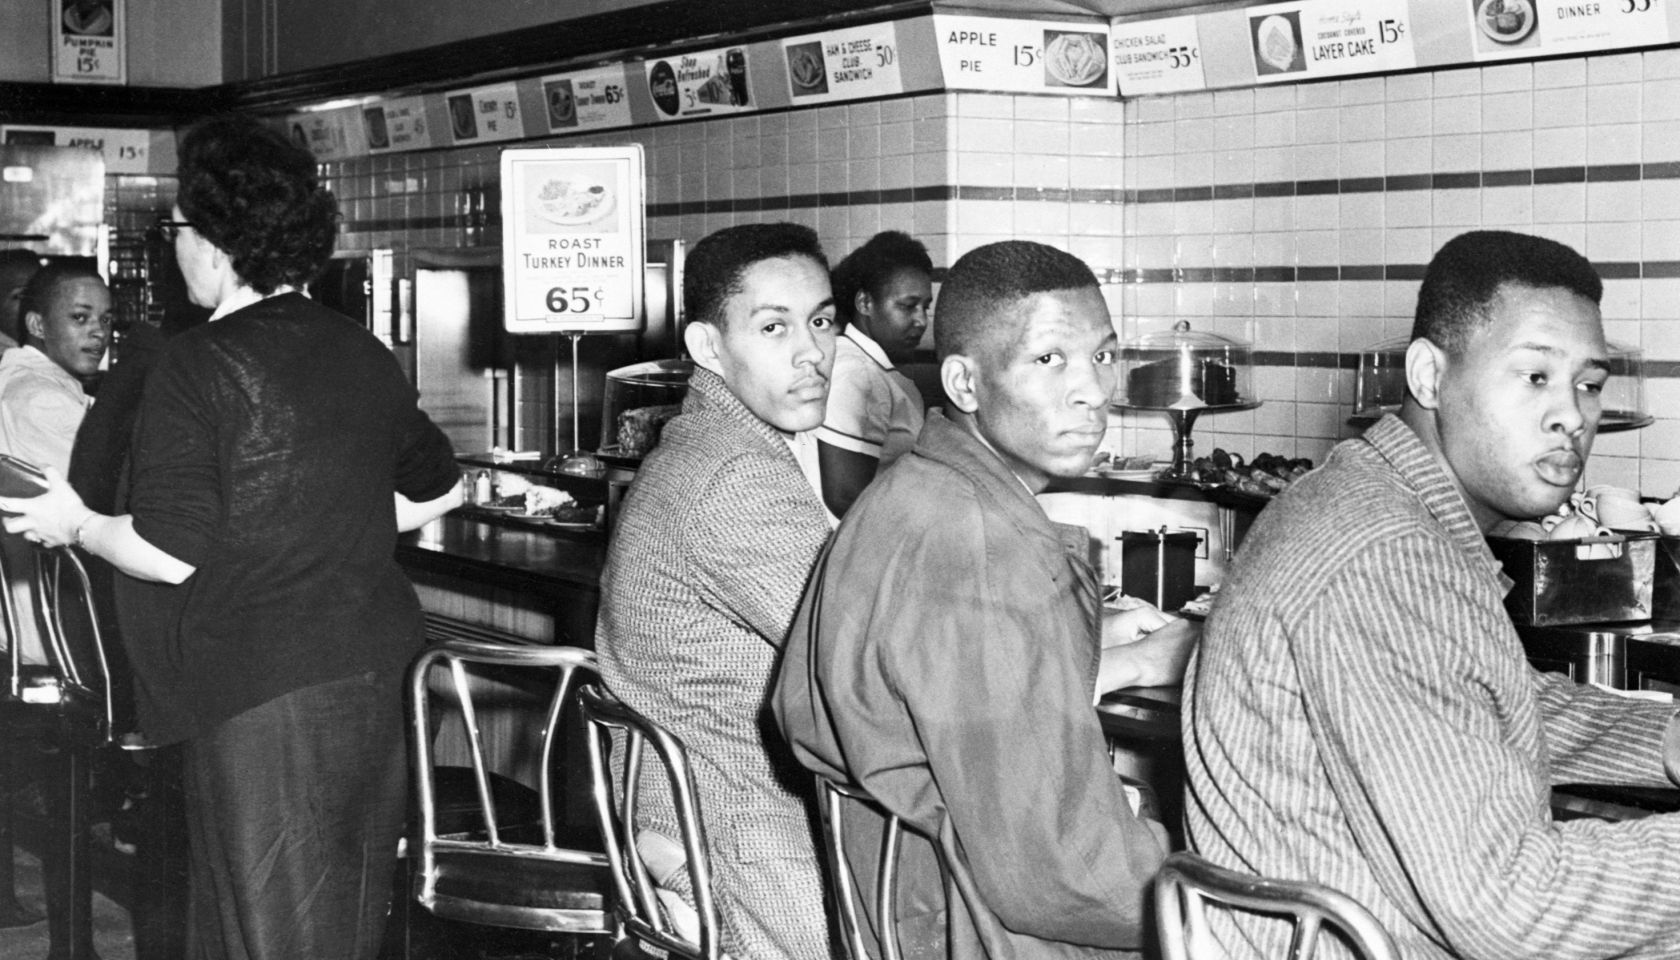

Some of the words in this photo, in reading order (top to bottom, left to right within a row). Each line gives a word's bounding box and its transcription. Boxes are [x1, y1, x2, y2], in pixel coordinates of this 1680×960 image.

[1557, 3, 1600, 19] DINNER
[948, 31, 997, 46] APPLE
[1379, 19, 1405, 44] 15¢
[64, 34, 114, 49] PUMPKIN
[826, 45, 840, 56] HAM
[848, 39, 872, 54] CHEESE
[1114, 36, 1143, 49] CHICKEN
[1145, 33, 1166, 46] SALAD
[80, 48, 96, 57] PIE
[1312, 42, 1344, 61] LAYER
[1348, 39, 1376, 57] CAKE
[842, 55, 860, 69] CLUB
[1115, 53, 1132, 65] CLUB
[1133, 51, 1168, 64] SANDWICH
[960, 60, 982, 72] PIE
[834, 68, 872, 83] SANDWICH
[549, 238, 602, 249] ROAST
[522, 253, 571, 269] TURKEY
[577, 252, 625, 268] DINNER
[545, 286, 605, 314] 65¢
